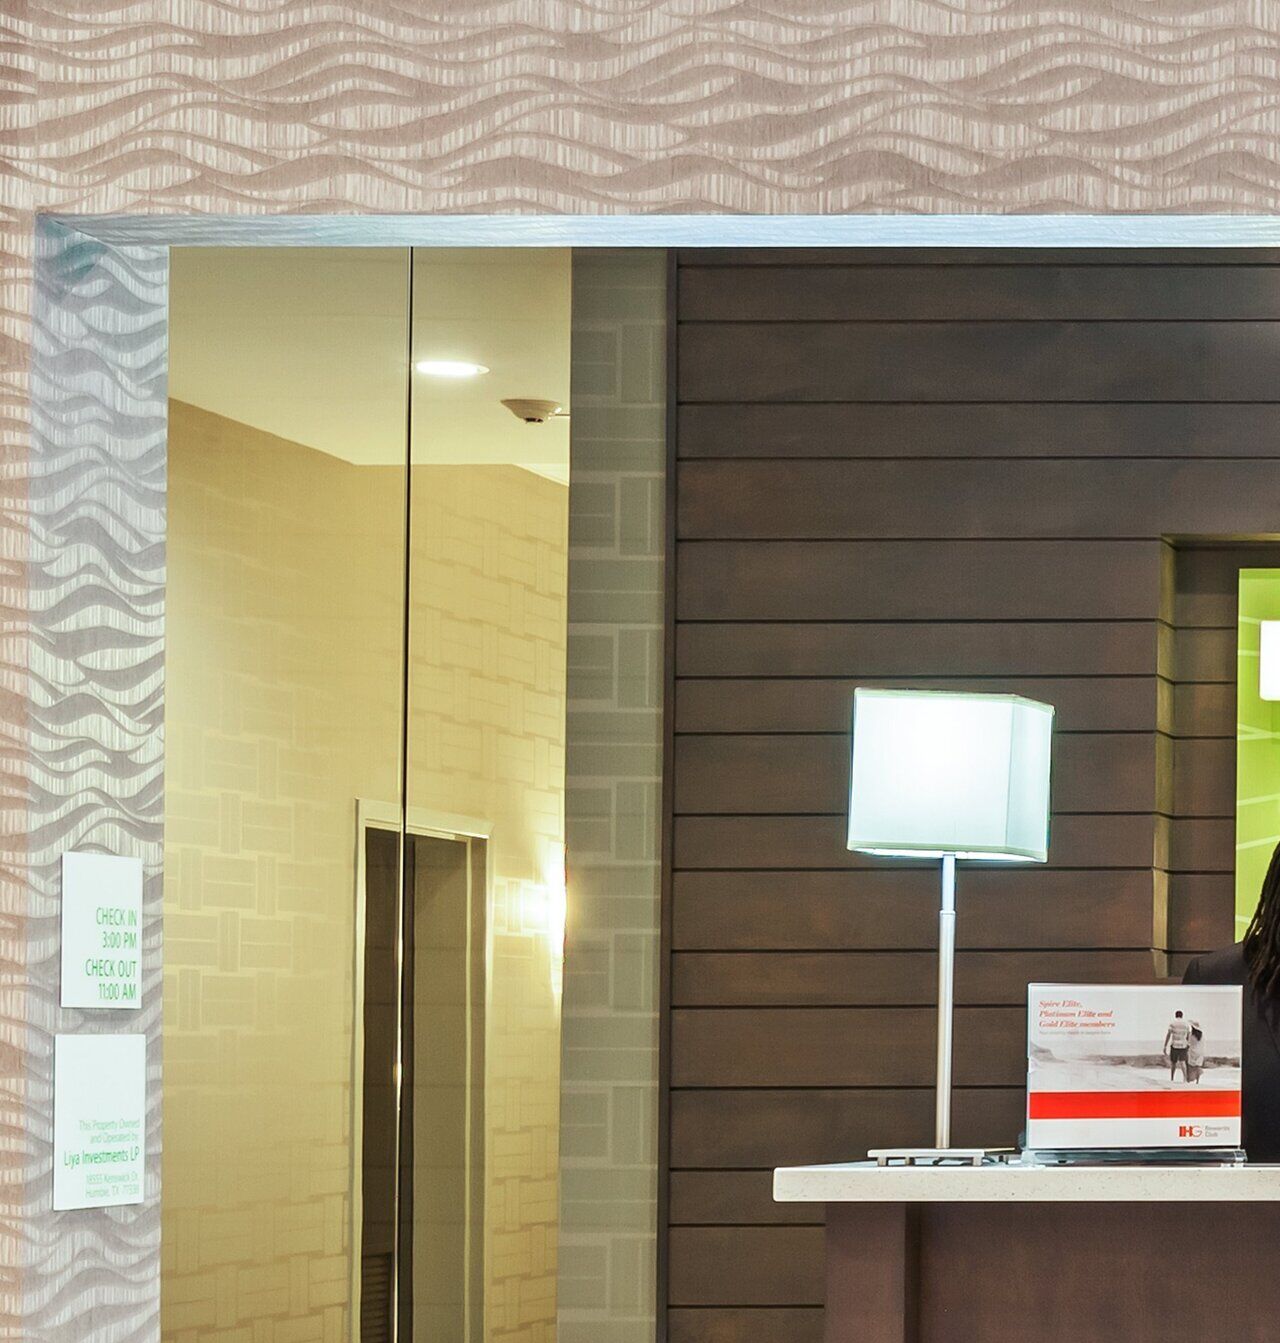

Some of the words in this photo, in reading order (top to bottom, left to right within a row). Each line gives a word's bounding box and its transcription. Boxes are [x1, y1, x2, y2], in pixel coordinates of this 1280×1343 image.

[96, 907, 125, 926] CHECK
[128, 909, 137, 926] IN
[102, 931, 121, 949] 3:00
[123, 932, 137, 949] PM
[85, 958, 115, 977] CHECK
[118, 960, 137, 978] OUT
[98, 983, 119, 1000] 11:00
[122, 983, 137, 1000] AM
[1038, 1000, 1060, 1009] Spire
[1039, 1010, 1076, 1018] Platinum
[1097, 1010, 1114, 1018] and
[1039, 1020, 1059, 1028] Gold
[1059, 1020, 1078, 1028] Elite
[1079, 1020, 1116, 1028] members
[1179, 1125, 1203, 1138] IHG
[63, 1150, 80, 1170] Liya
[82, 1149, 128, 1164] Investments
[131, 1146, 140, 1161] LP
